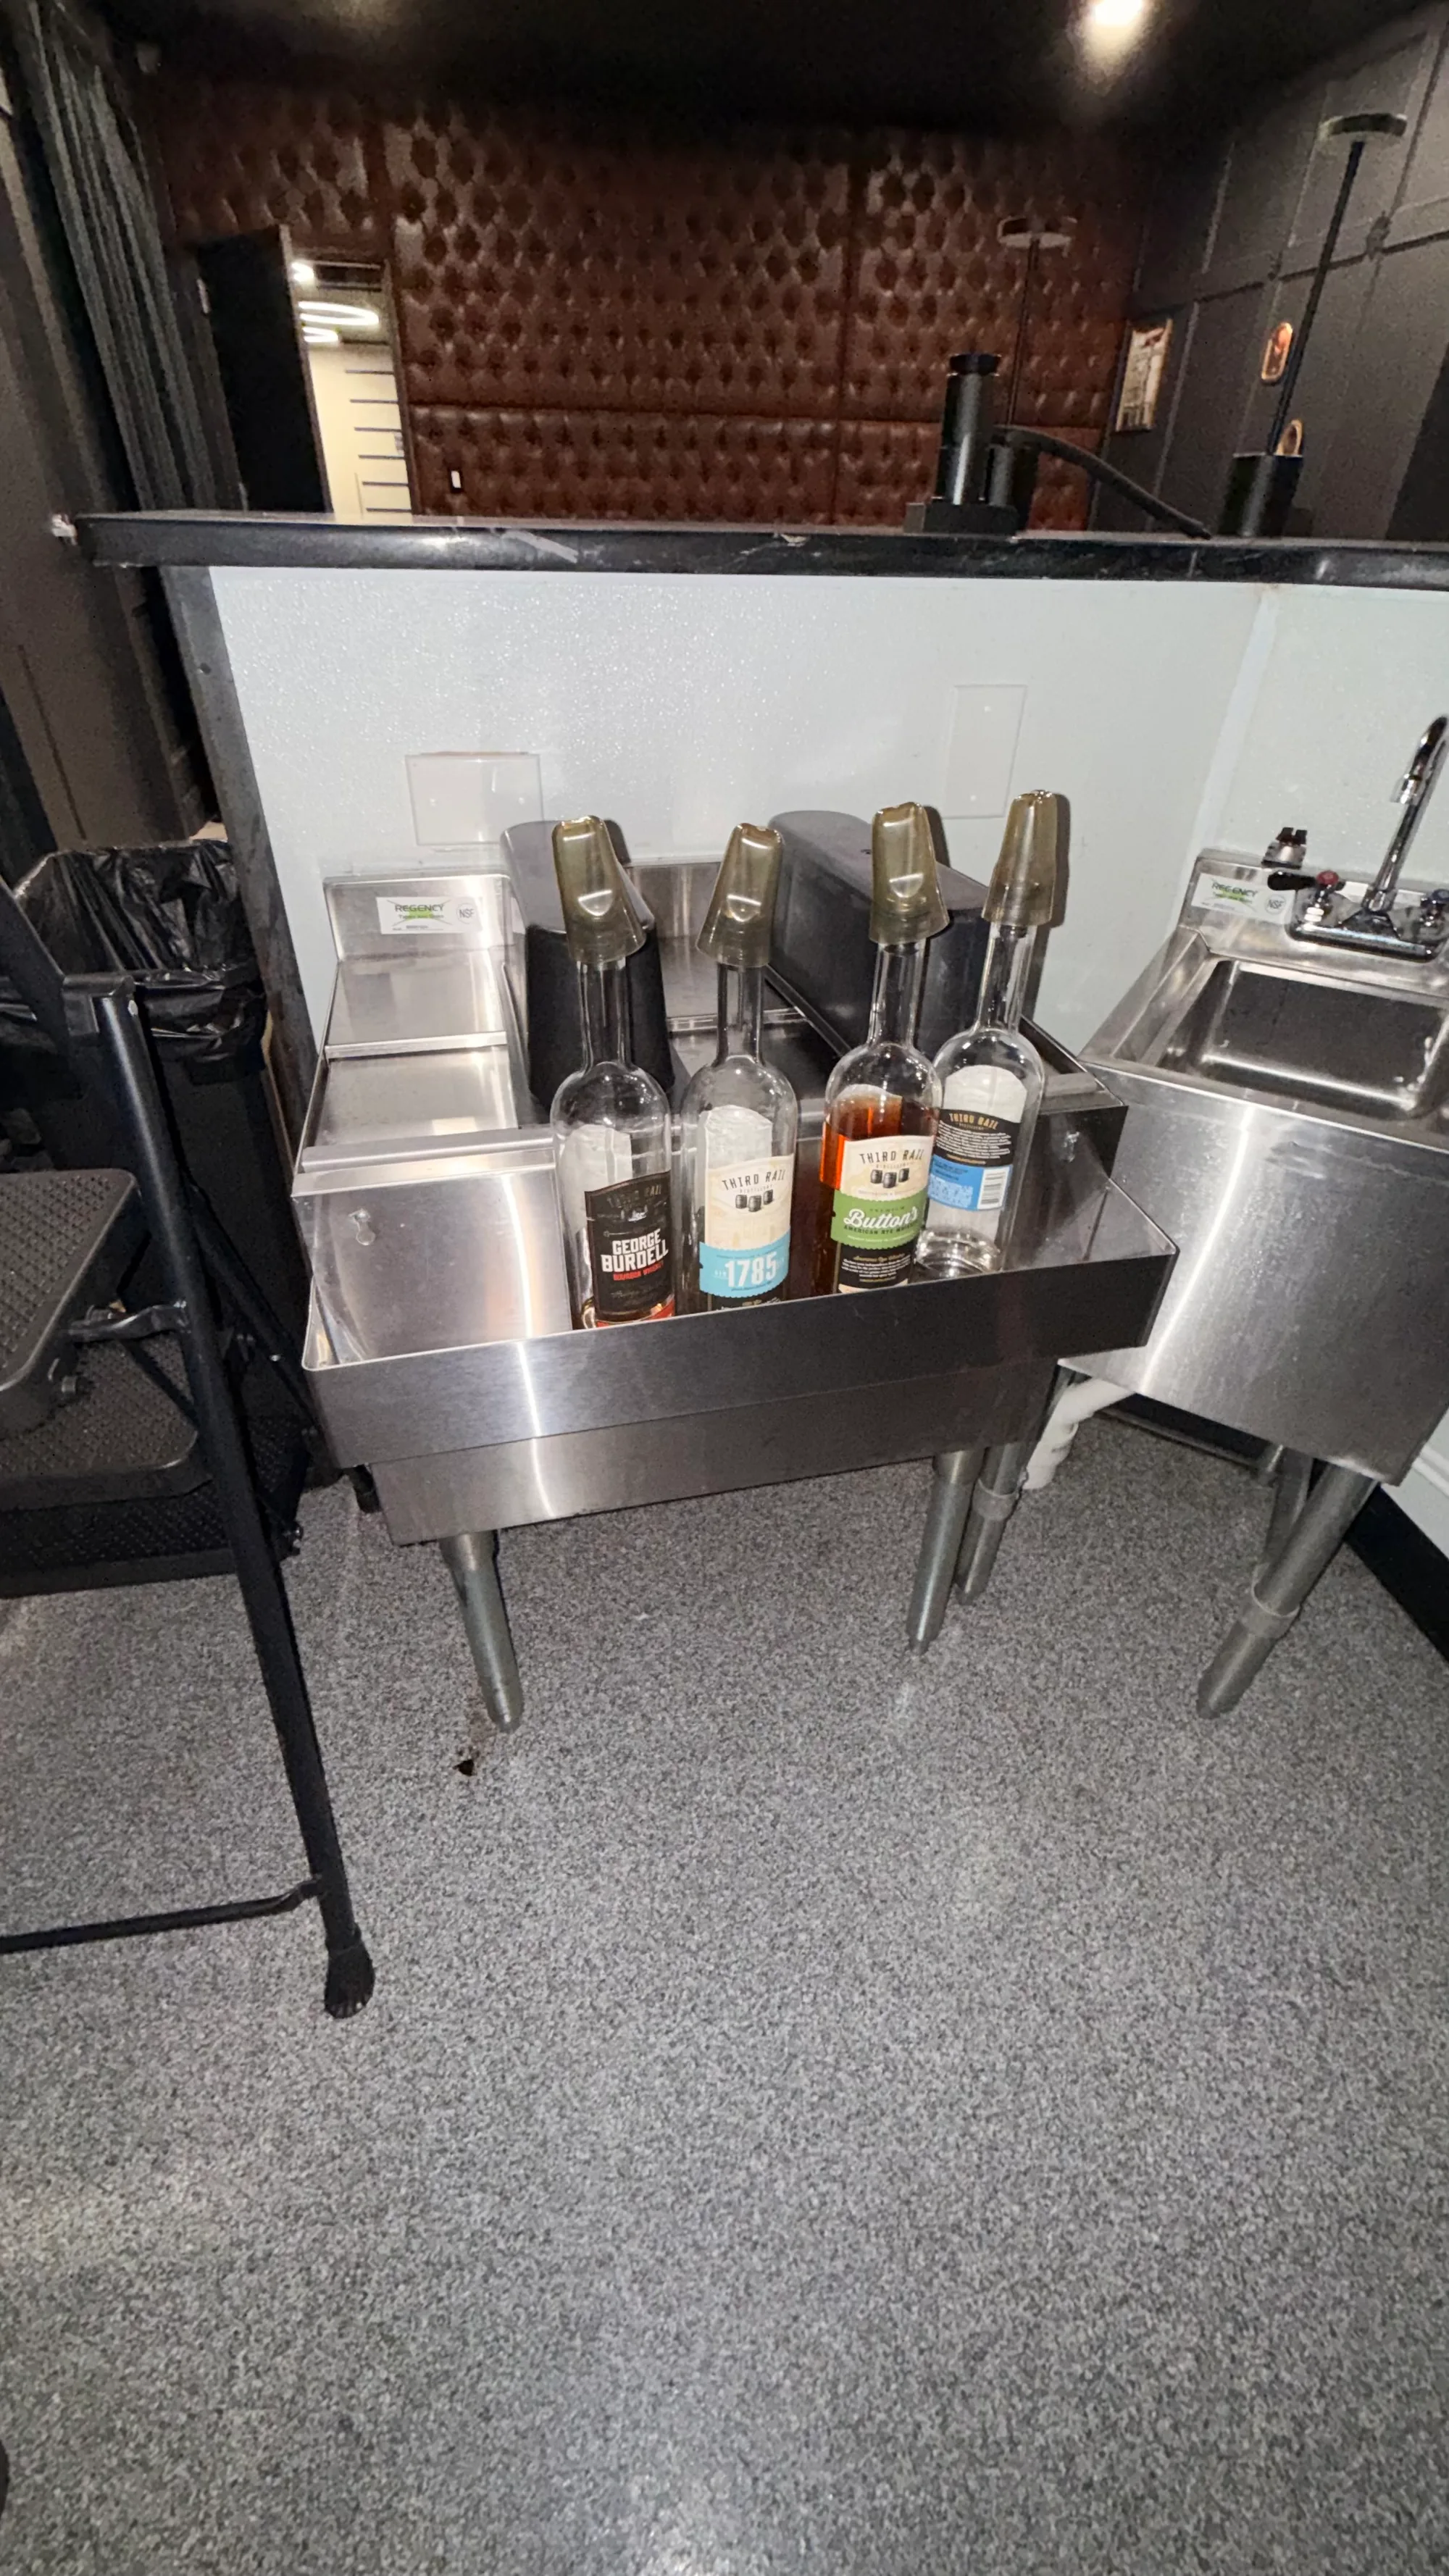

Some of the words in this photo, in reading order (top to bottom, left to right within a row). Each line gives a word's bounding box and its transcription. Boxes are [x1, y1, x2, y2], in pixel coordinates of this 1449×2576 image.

[1211, 882, 1258, 897] REGENCY
[459, 908, 475, 919] NSF
[949, 1113, 975, 1124] THIRD
[977, 1116, 999, 1130] RAIL
[859, 1150, 897, 1165] THIRD
[903, 1149, 925, 1161] RAIL
[722, 1174, 759, 1191] THIRD
[765, 1169, 786, 1182] RAIL
[843, 1206, 917, 1229] Button's
[843, 1224, 879, 1235] AMERICAN
[612, 1228, 661, 1255] GEORGE
[601, 1239, 669, 1273] BURDELL
[724, 1251, 777, 1287] 1785
